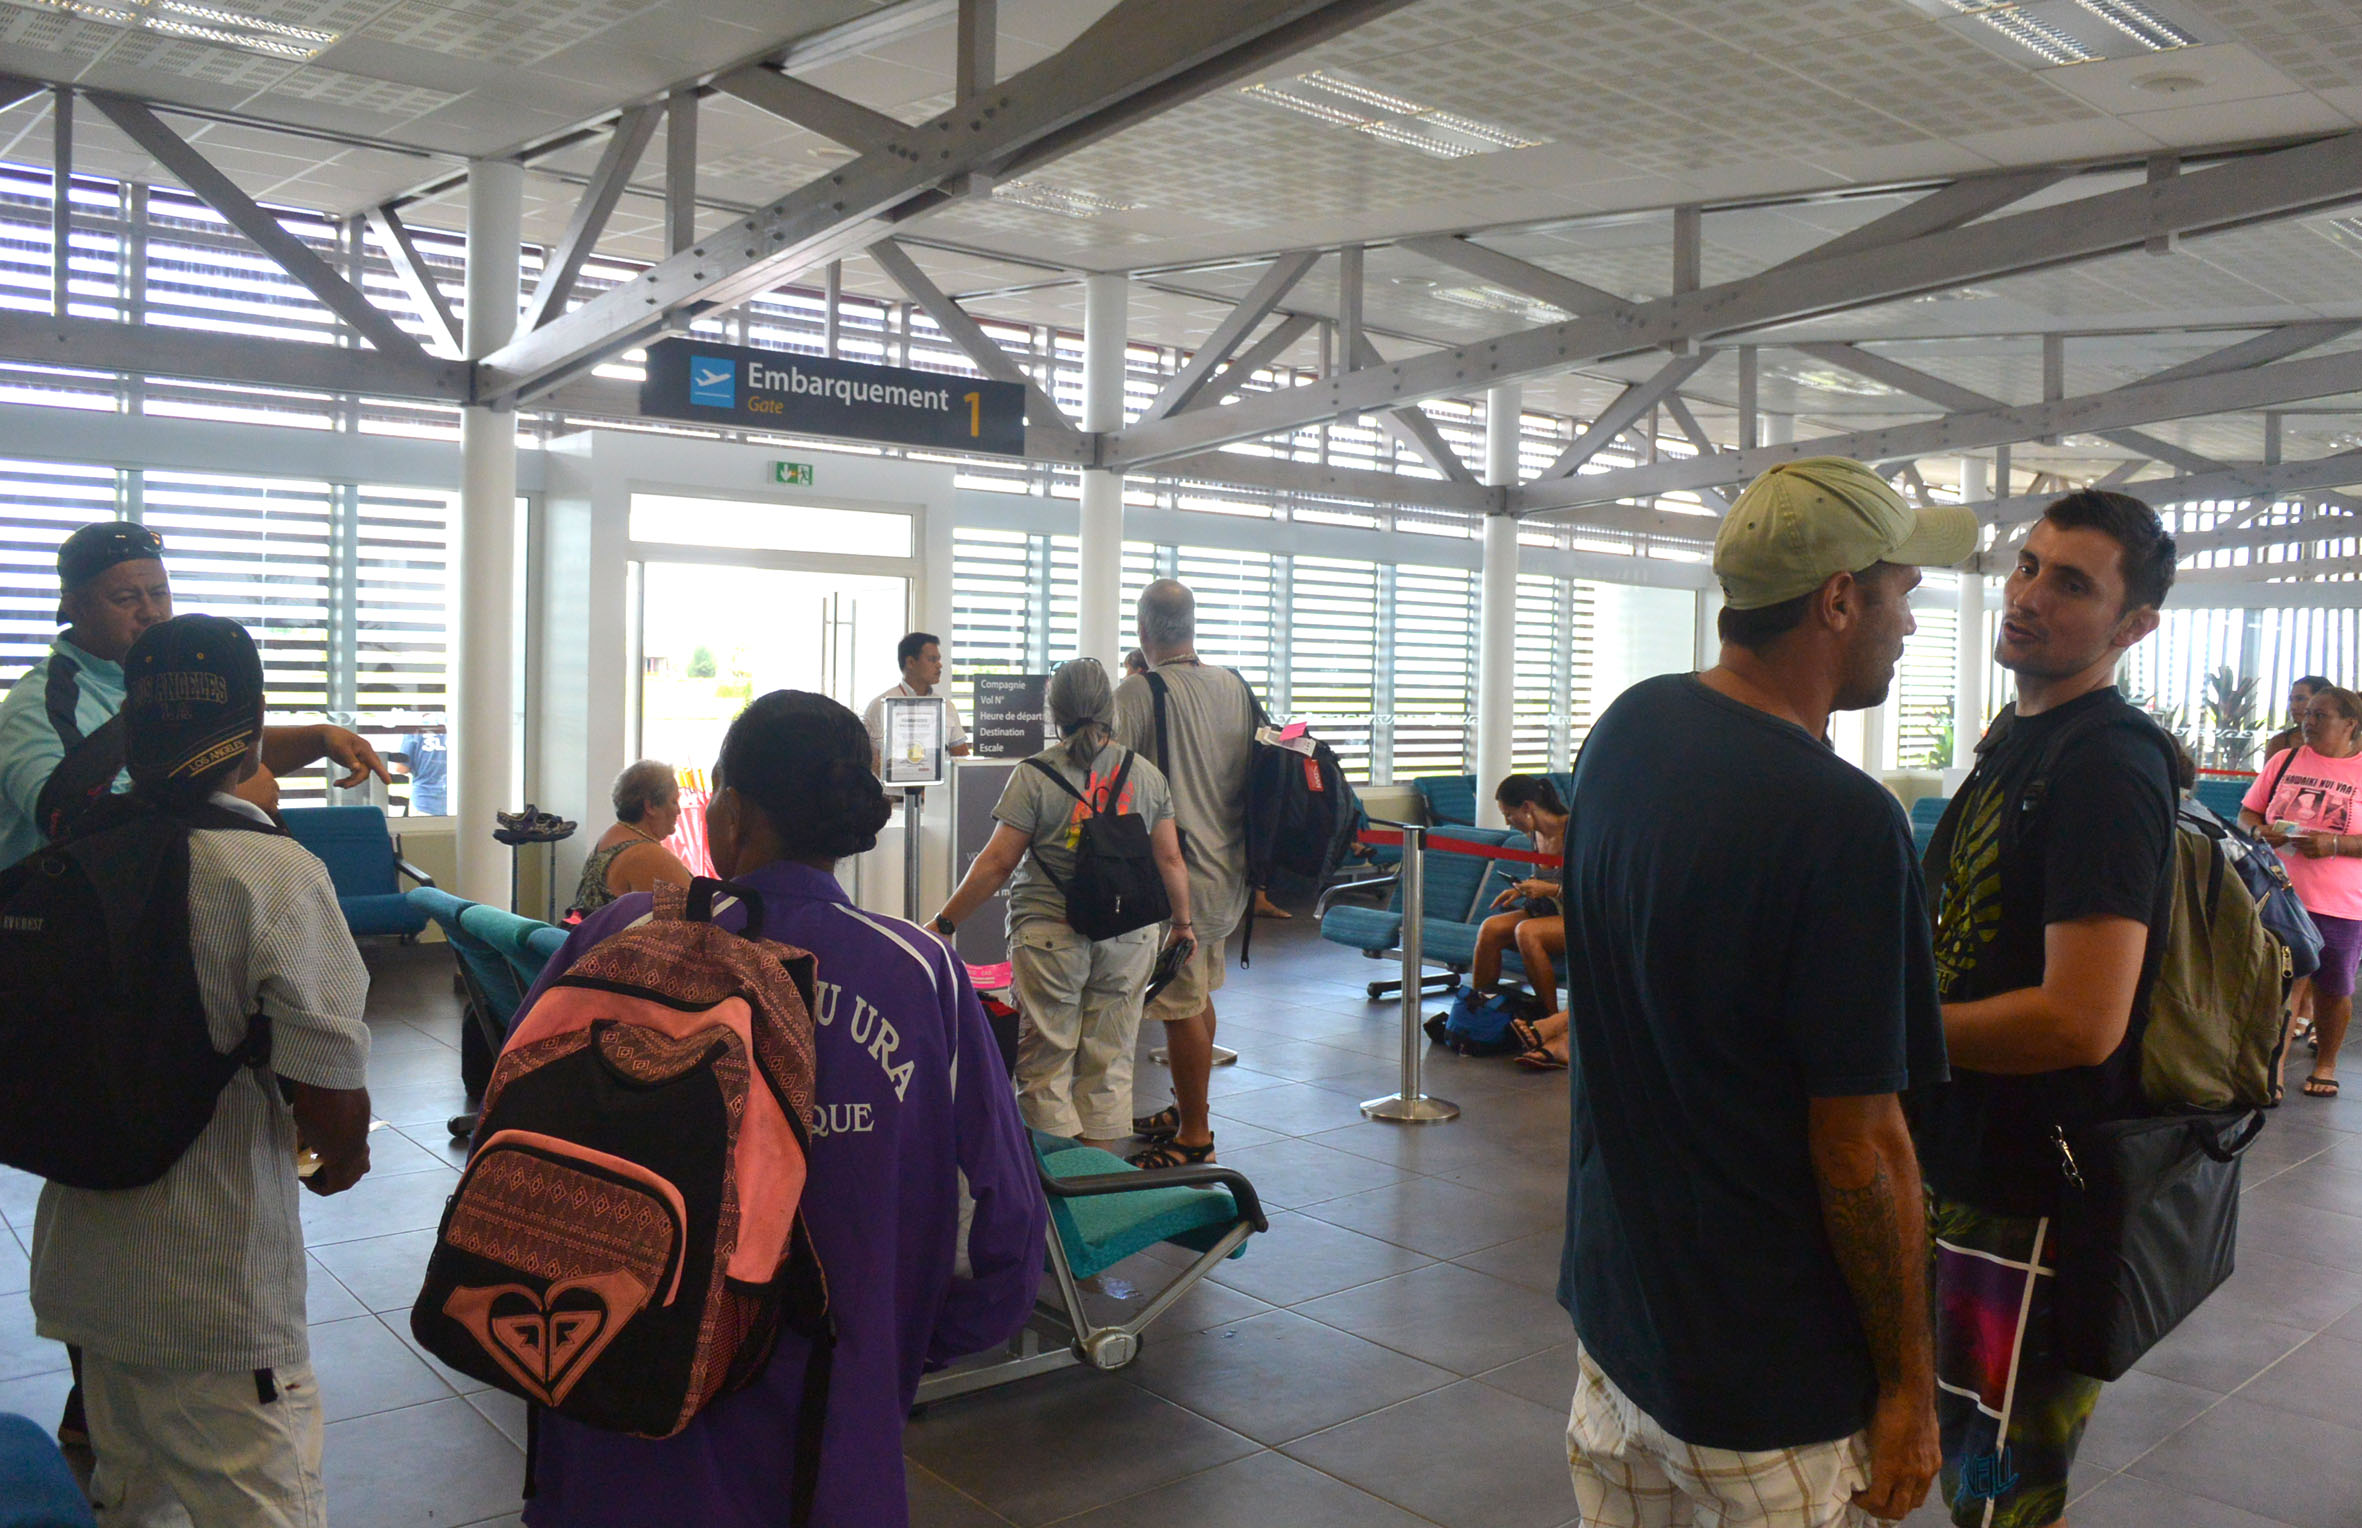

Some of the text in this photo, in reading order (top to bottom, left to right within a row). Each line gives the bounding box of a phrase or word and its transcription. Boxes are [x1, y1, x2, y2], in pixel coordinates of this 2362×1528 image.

[747, 396, 784, 415] Gate
[748, 362, 981, 438] Embarquement 1
[980, 679, 1026, 691] Compagnie
[980, 695, 994, 705] Vol
[979, 711, 1043, 722] Heure de départ
[979, 727, 1025, 737] Destination
[979, 743, 1004, 753] Escale
[188, 740, 246, 772] LOS ANGELES
[850, 994, 916, 1103] URA
